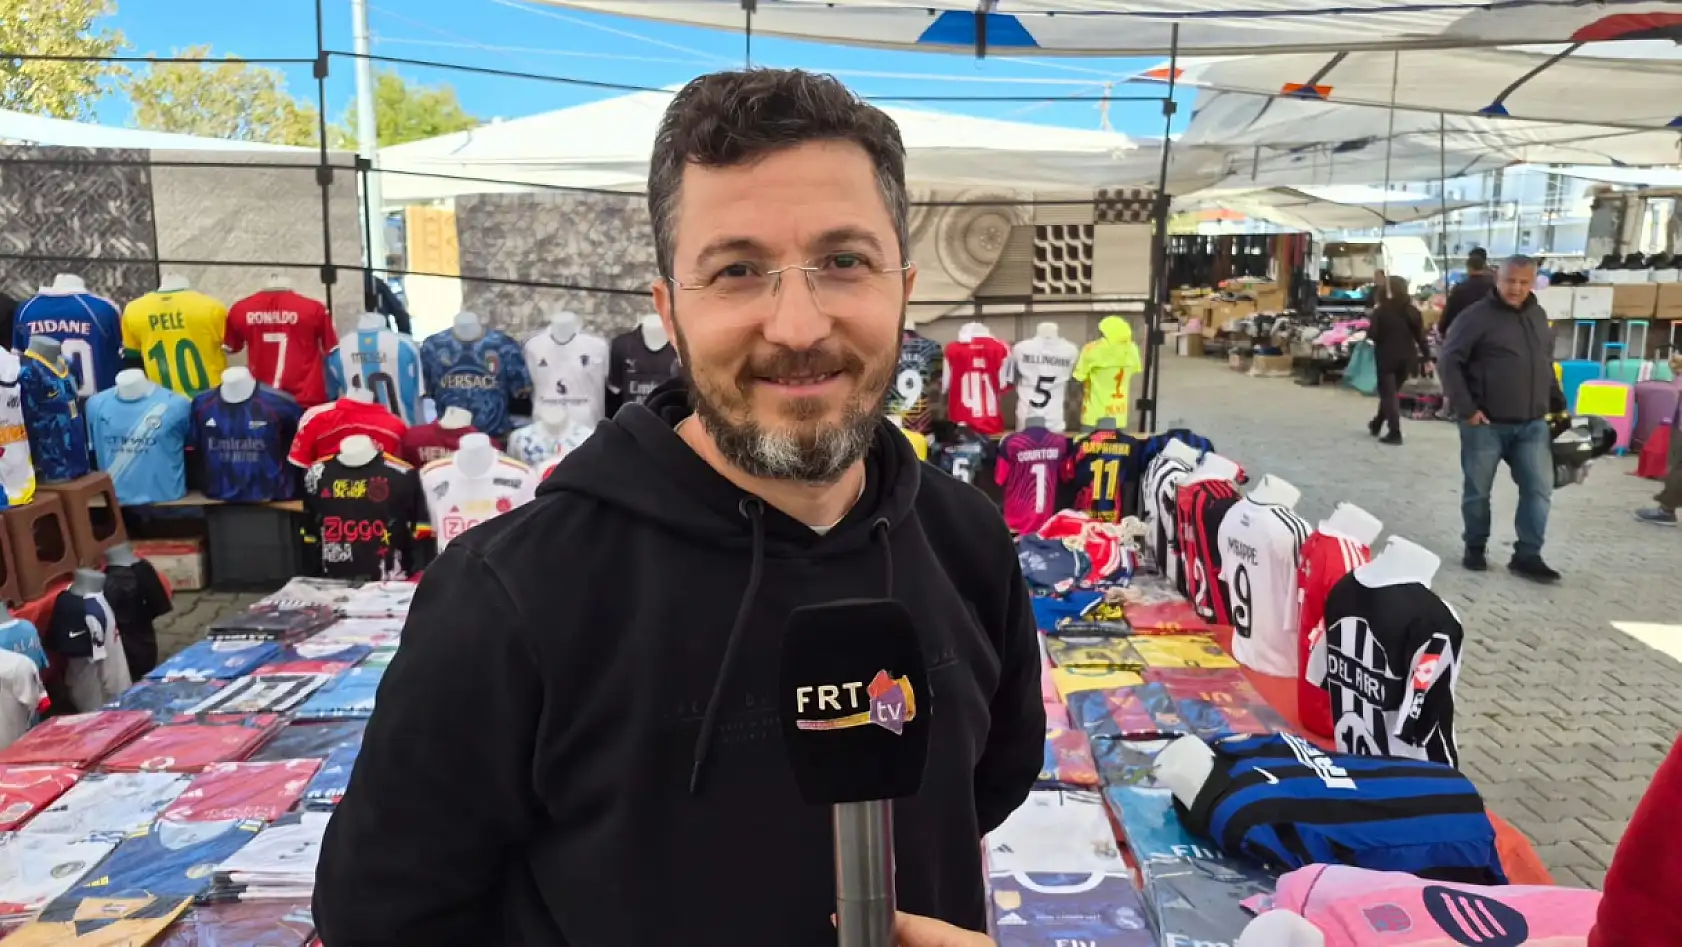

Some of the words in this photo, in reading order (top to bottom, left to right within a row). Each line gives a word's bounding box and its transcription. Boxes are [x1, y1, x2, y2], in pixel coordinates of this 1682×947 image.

[27, 319, 92, 335] ZIDANE
[246, 311, 298, 325] RONALDO
[148, 338, 210, 398] 10
[263, 332, 287, 389] 7
[961, 370, 997, 418] 41
[1028, 375, 1056, 409] 5
[1030, 463, 1046, 514] 1
[1090, 458, 1120, 501] 11
[1234, 563, 1252, 638] 9
[1328, 653, 1353, 684] DEL
[796, 681, 862, 712] FRT
[877, 701, 902, 722] tv
